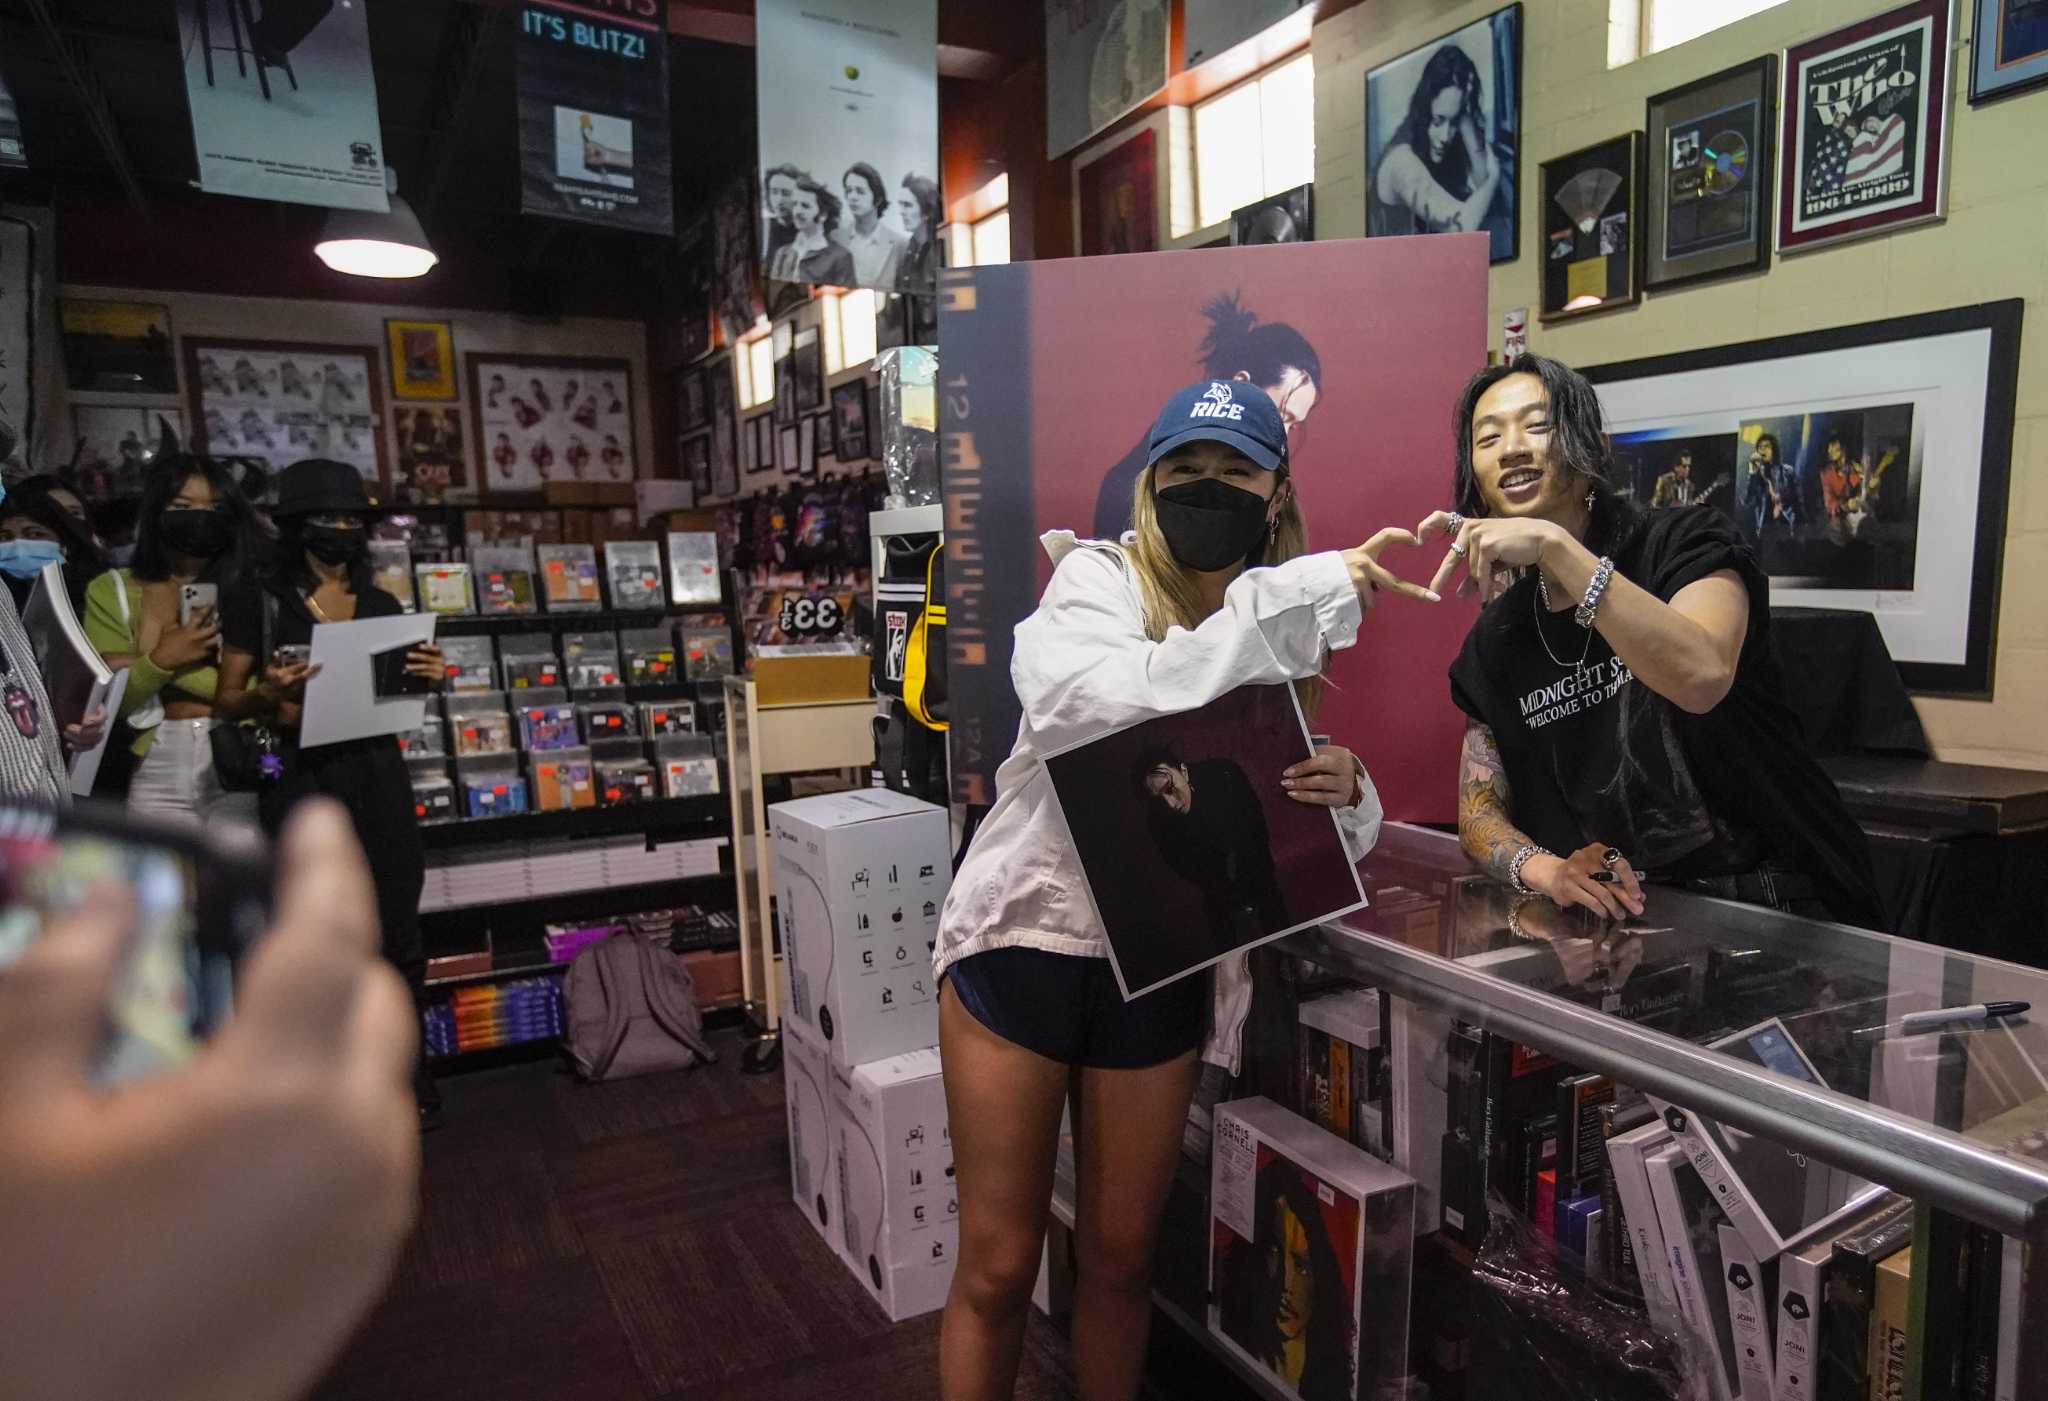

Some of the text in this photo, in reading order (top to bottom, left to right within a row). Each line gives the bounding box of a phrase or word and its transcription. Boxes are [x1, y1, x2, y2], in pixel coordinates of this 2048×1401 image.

[522, 9, 646, 58] IT'S BLITZ!
[1809, 58, 1888, 103] The
[1812, 70, 1917, 126] Who
[1189, 402, 1246, 420] RICE
[1519, 662, 1605, 716] MIDNIGHT
[1582, 689, 1602, 708] TO
[1217, 1123, 1256, 1154] CORNELL
[1223, 1117, 1250, 1140] CHRIS
[1737, 1312, 1756, 1324] JONI
[1784, 1339, 1806, 1353] JONI
